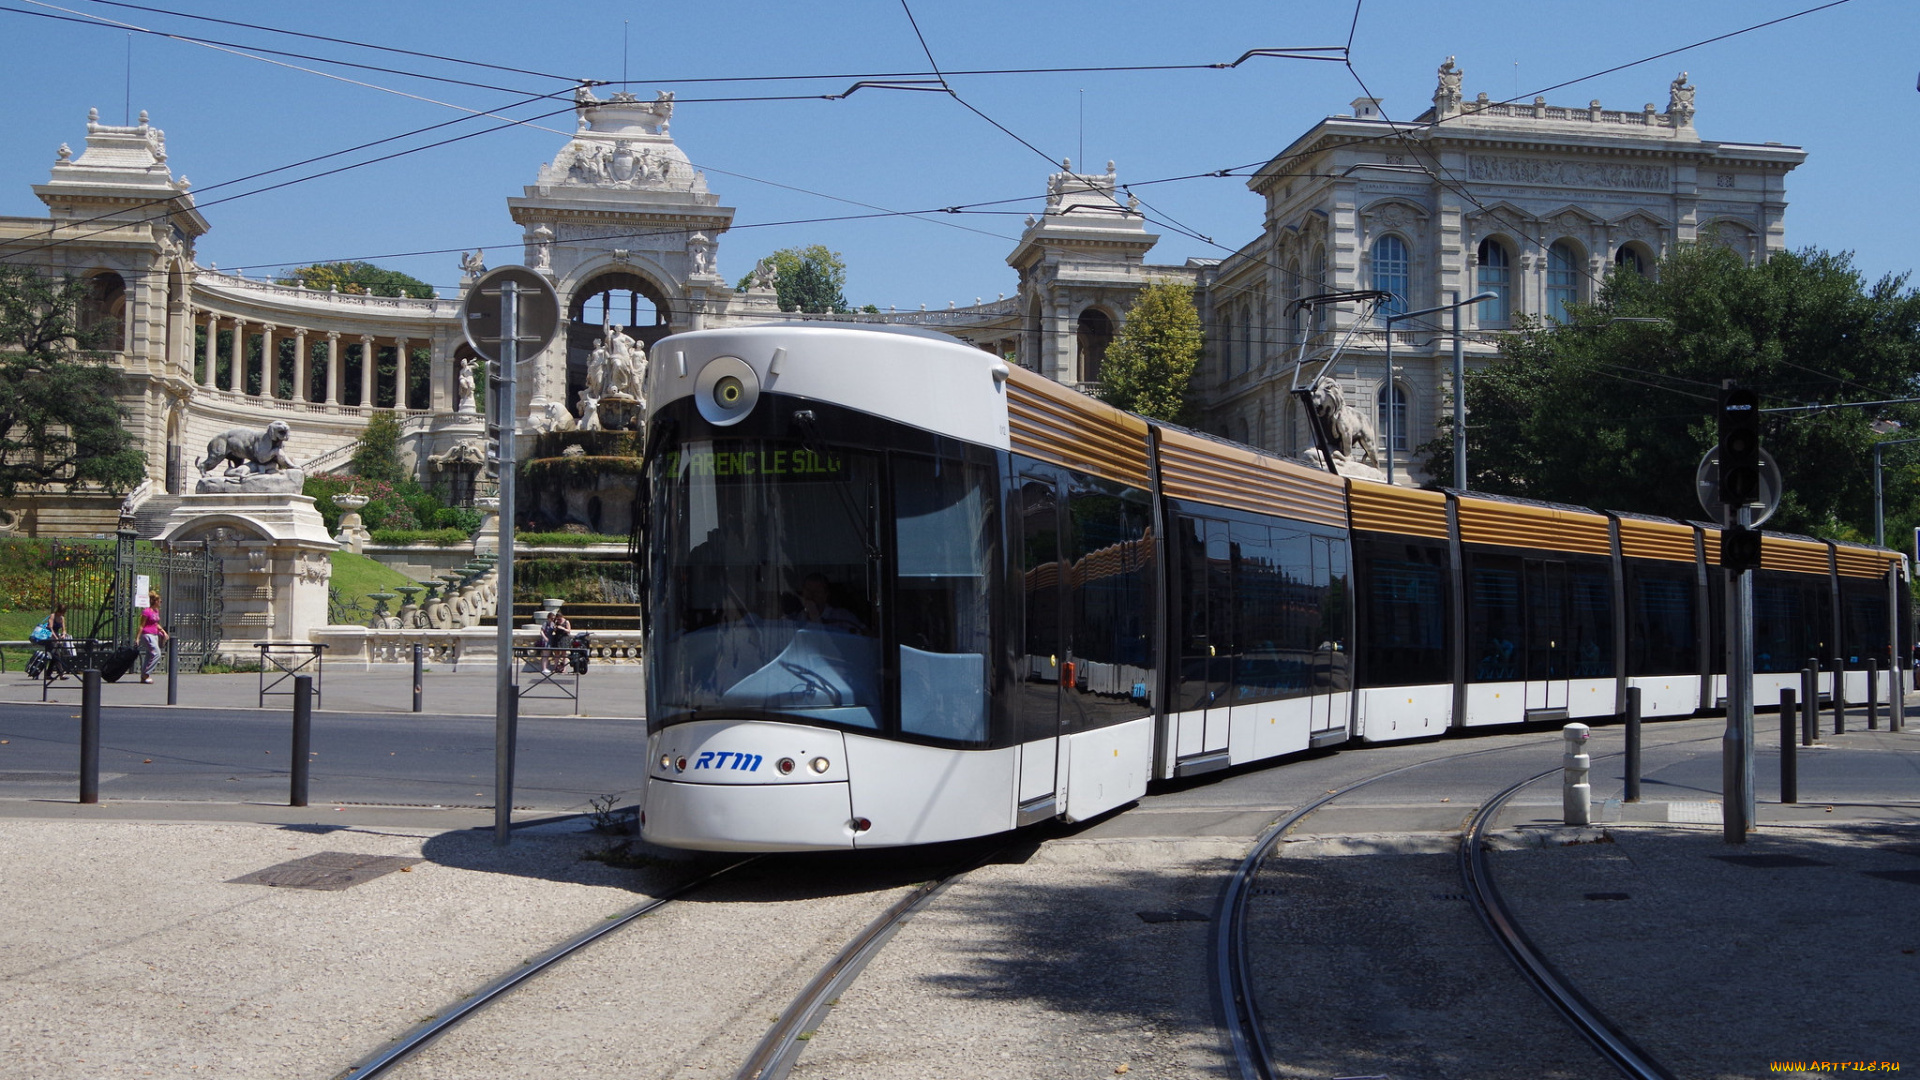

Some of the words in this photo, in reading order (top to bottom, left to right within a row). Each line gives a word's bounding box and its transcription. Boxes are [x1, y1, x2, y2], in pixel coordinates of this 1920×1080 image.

[690, 451, 756, 476] ARENC
[760, 450, 787, 474] LE
[694, 751, 763, 772] RTM
